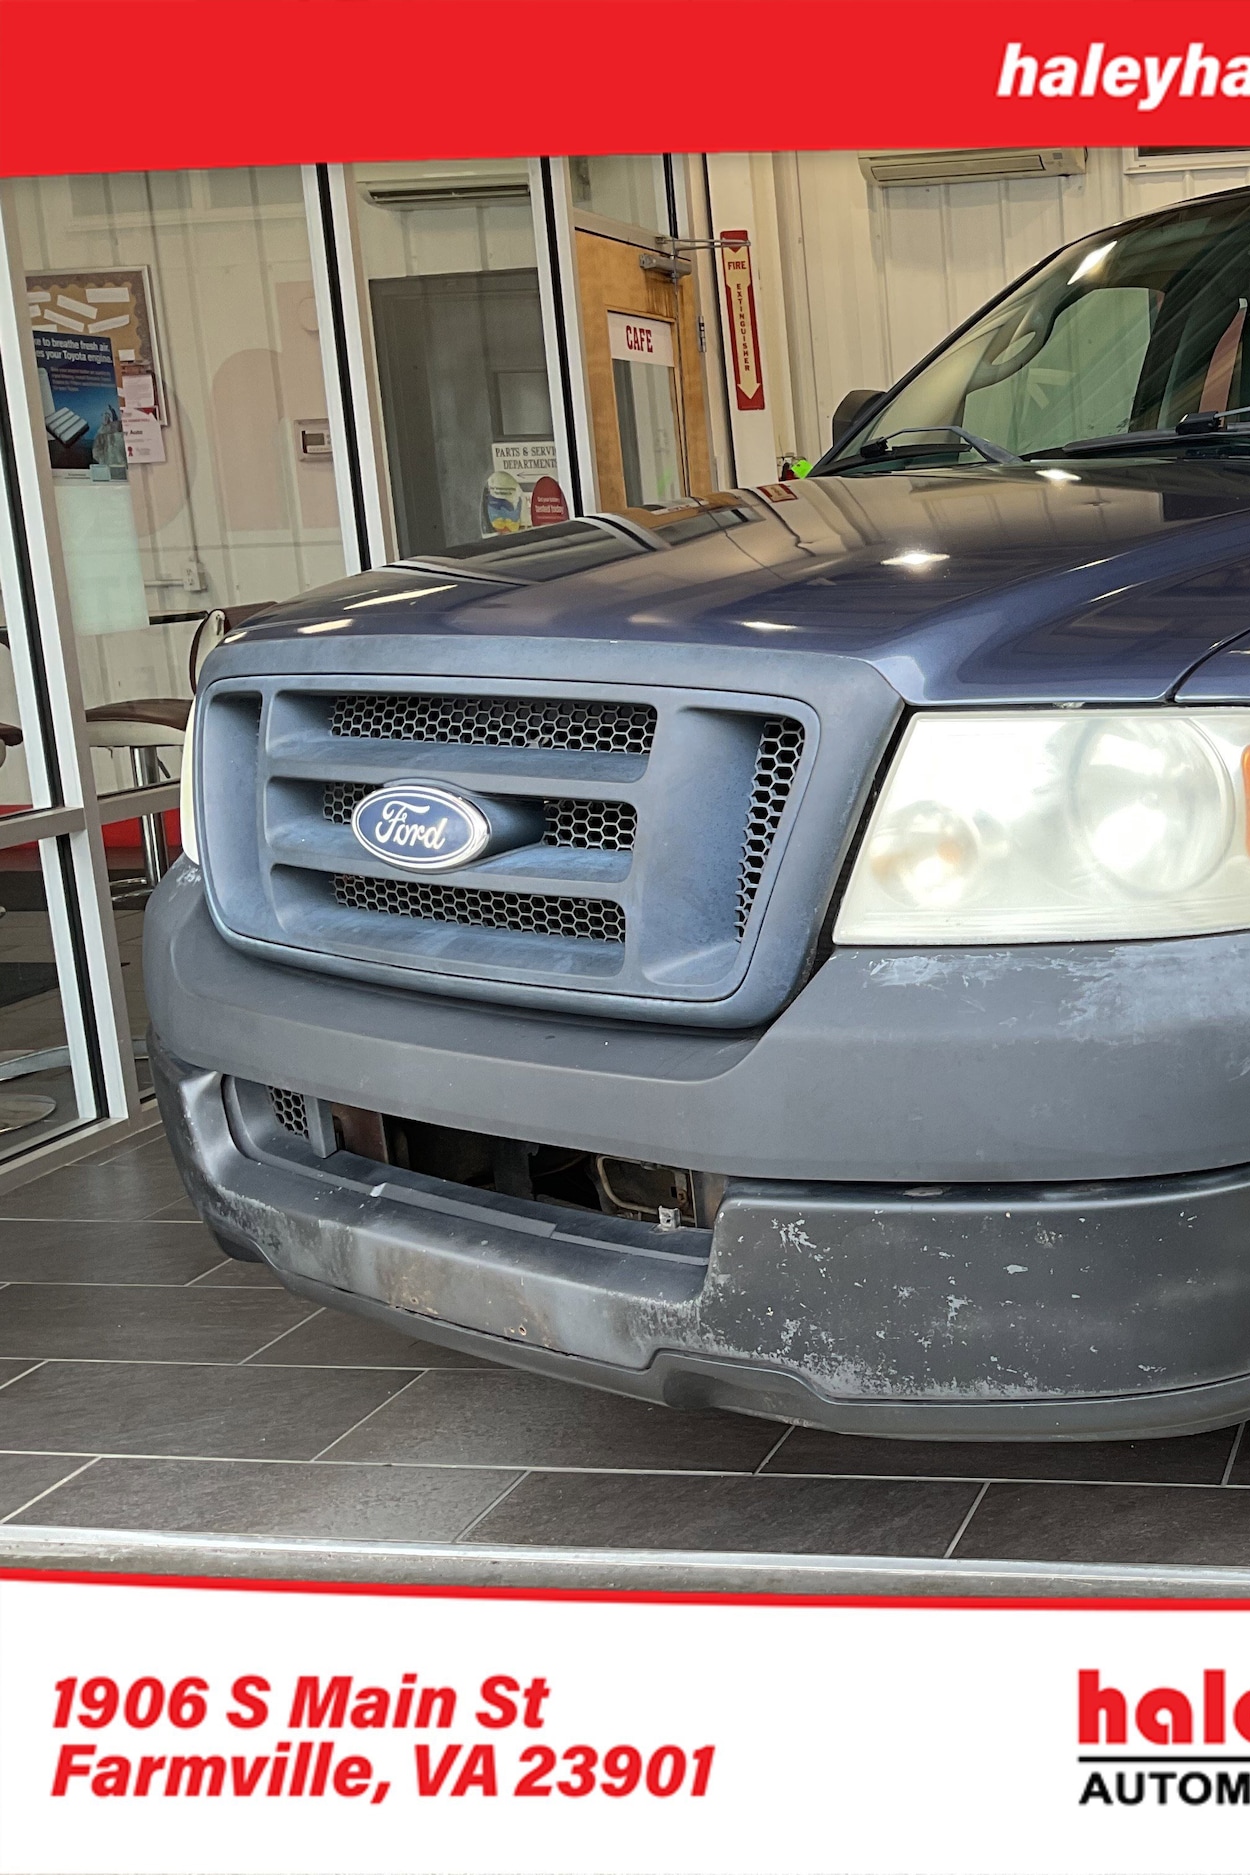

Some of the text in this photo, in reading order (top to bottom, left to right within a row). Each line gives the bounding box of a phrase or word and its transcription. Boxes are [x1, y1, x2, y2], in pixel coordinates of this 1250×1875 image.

[727, 261, 747, 270] FIRE
[736, 283, 750, 371] EXTINGUISHER
[42, 337, 51, 347] to
[51, 338, 79, 350] breathe
[80, 340, 98, 351] fresh
[625, 325, 653, 353] CAFE
[45, 350, 62, 360] your
[62, 350, 87, 362] Toyota
[495, 447, 520, 457] PARTS
[522, 446, 529, 457] &
[375, 800, 448, 850] Ford
